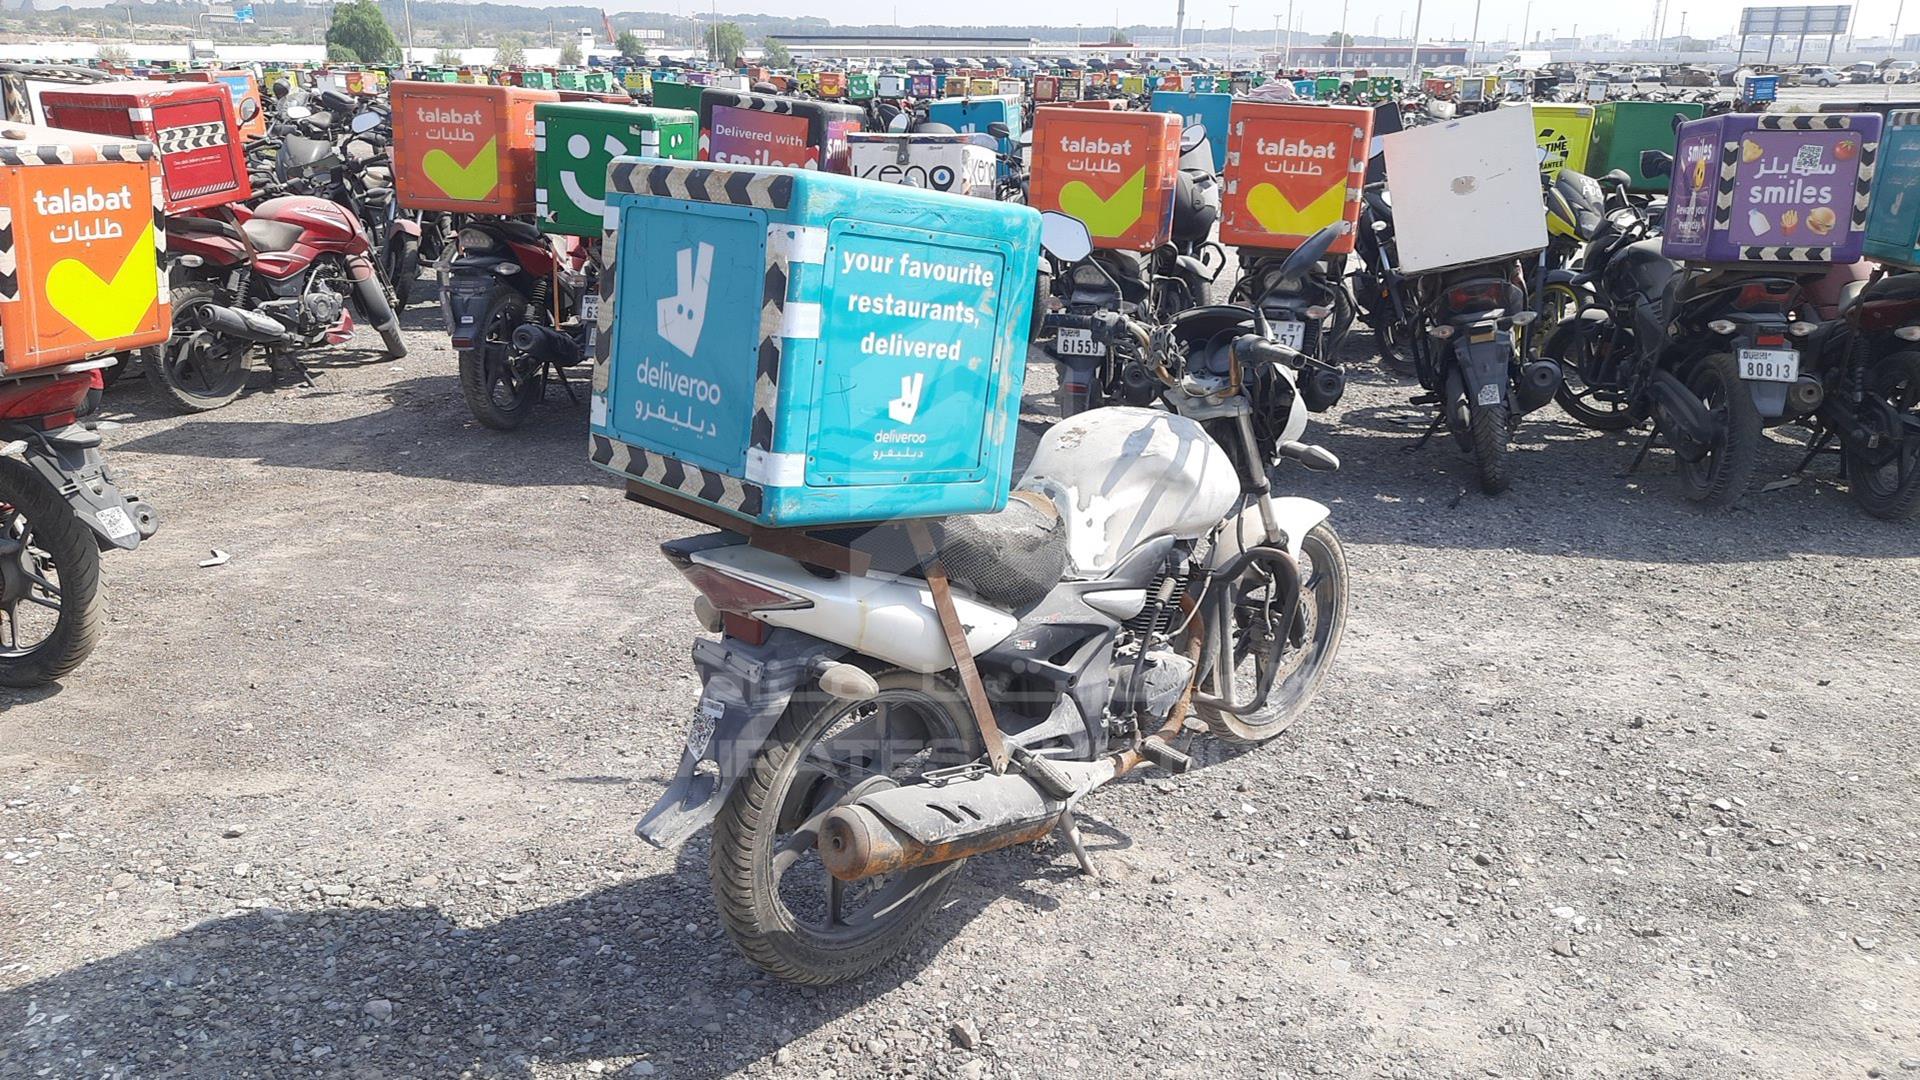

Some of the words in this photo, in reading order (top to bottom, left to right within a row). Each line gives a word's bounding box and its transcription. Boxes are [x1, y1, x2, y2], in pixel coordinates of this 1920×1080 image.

[416, 107, 482, 125] talabat
[425, 126, 474, 145] طلبات
[715, 124, 772, 142] Delivered
[775, 134, 803, 147] with
[1059, 136, 1132, 156] talabat
[1545, 140, 1568, 152] TIME
[1256, 137, 1336, 159] talabat
[1688, 139, 1712, 162] smiles
[1067, 157, 1120, 176] طلبات
[1264, 159, 1322, 178] طلبات
[33, 185, 131, 215] talabat
[1748, 178, 1832, 204] smiles
[49, 217, 122, 247] طلبات
[842, 250, 894, 274] your
[899, 253, 994, 288] favourite
[848, 293, 979, 328] restaurants,
[860, 331, 961, 361] delivered
[1063, 339, 1099, 354] 61559
[637, 356, 721, 405] deliveroo
[1747, 362, 1790, 379] 80813
[635, 398, 716, 440] ديليفرو
[874, 429, 927, 444] deliveroo
[873, 447, 924, 461] ديليفرو
